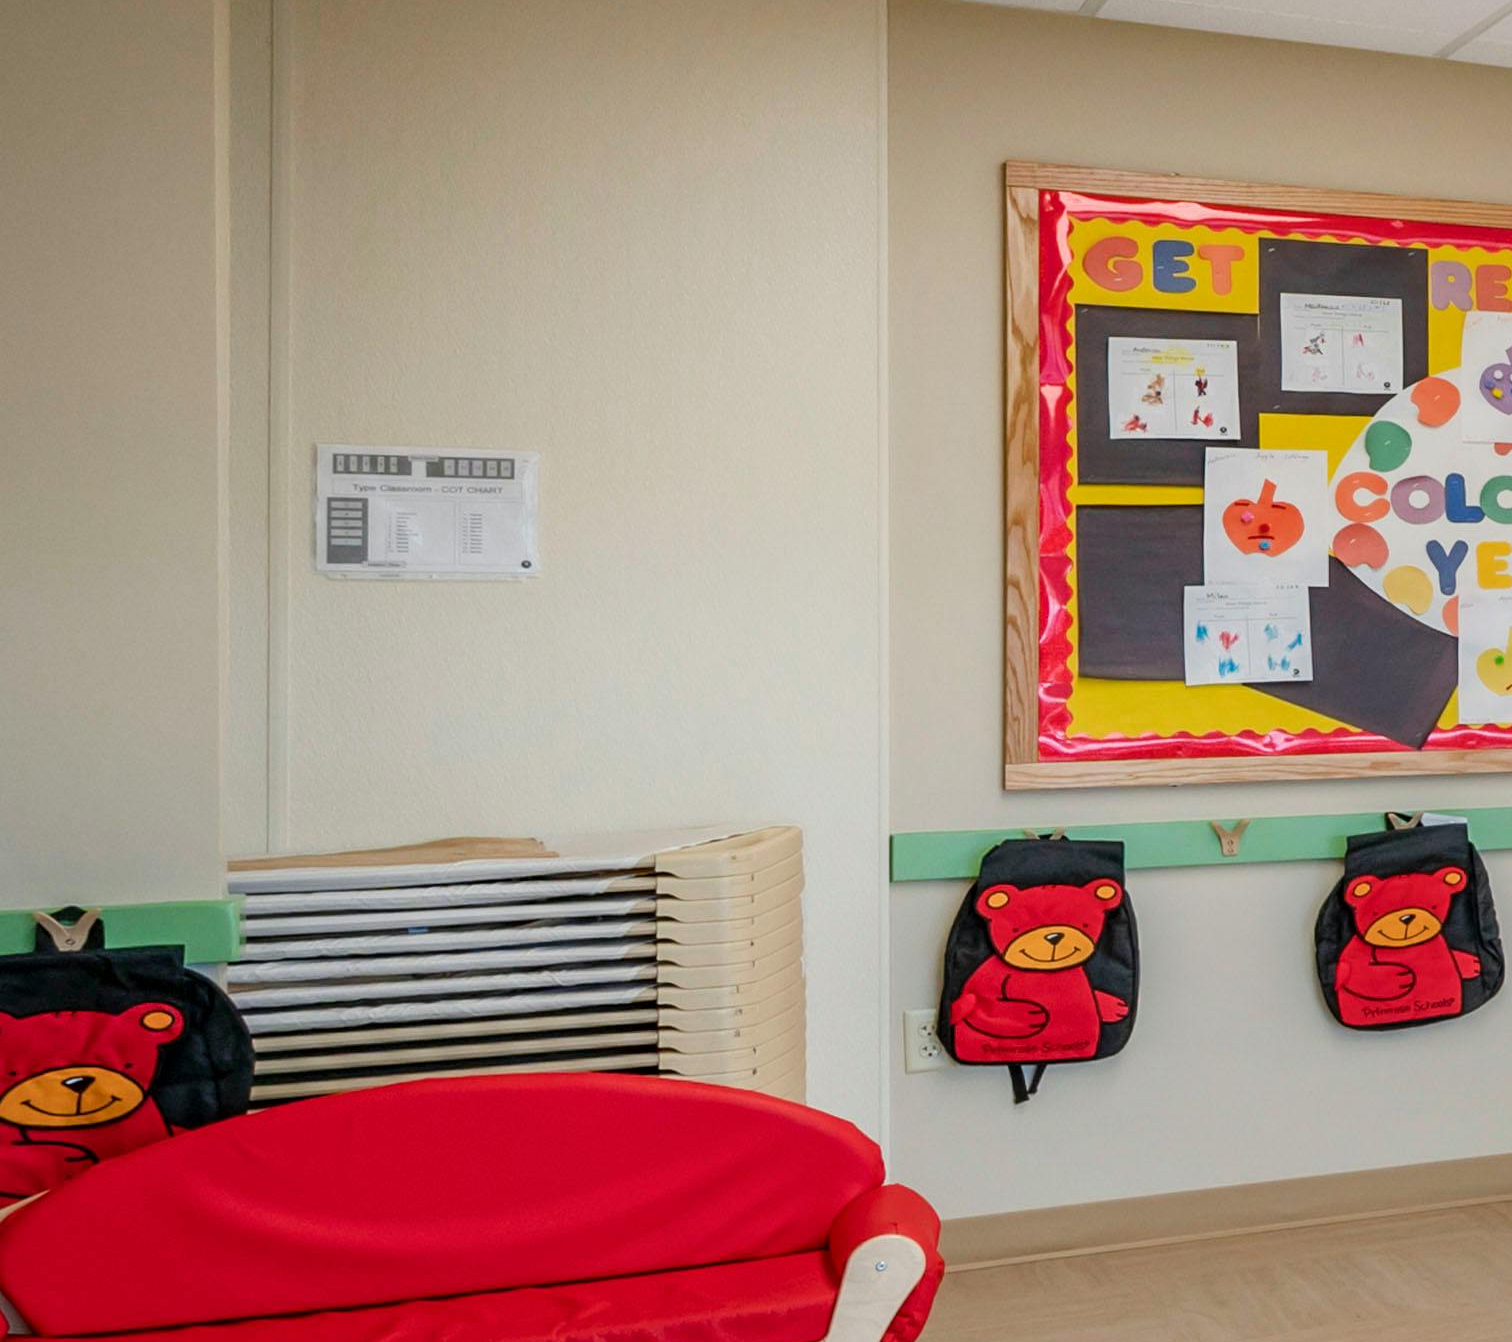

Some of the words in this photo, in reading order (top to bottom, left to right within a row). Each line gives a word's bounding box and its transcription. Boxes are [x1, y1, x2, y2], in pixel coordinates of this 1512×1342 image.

[1083, 236, 1246, 296] GET
[353, 483, 377, 494] Type
[380, 484, 432, 494] Classroom
[466, 486, 503, 495] CHART
